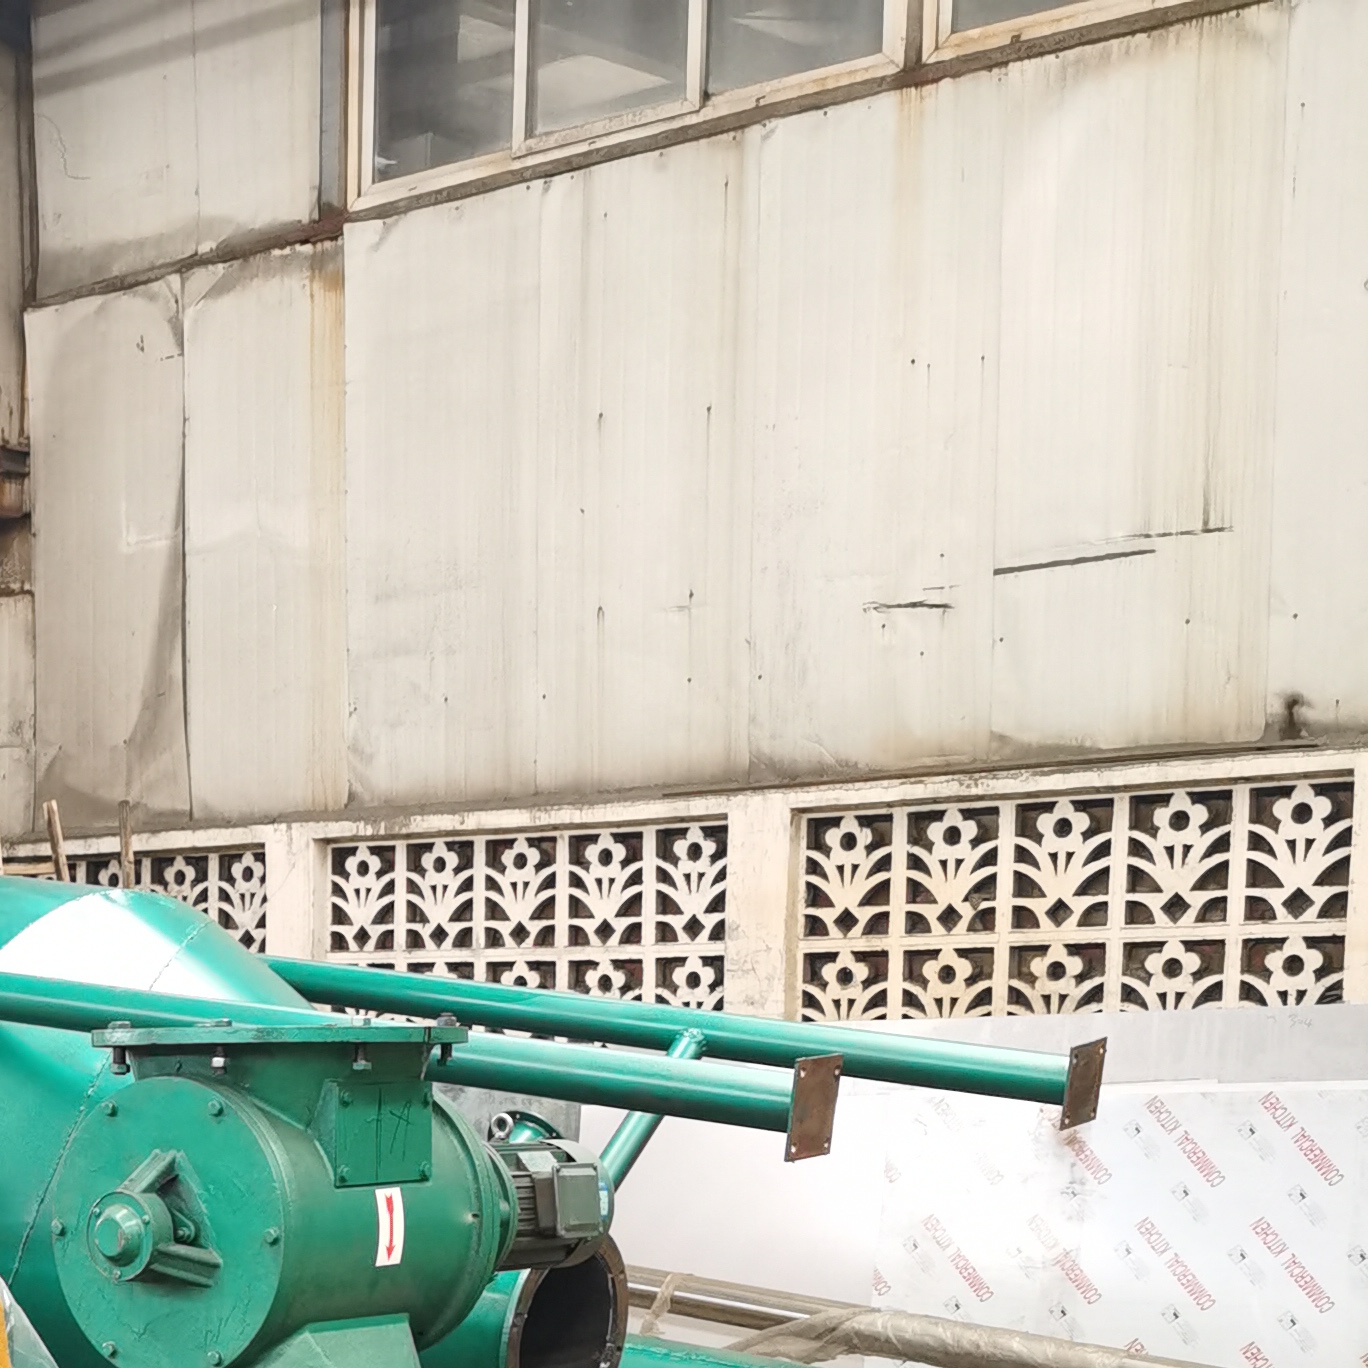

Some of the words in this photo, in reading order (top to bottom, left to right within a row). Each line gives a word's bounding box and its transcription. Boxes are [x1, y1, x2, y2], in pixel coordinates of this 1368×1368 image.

[1144, 1095, 1182, 1136] KITCHEN
[1258, 1090, 1298, 1132] KITCHEN
[1174, 1129, 1226, 1188] COMMERCIAL
[1291, 1126, 1345, 1187] COMMERCIAL
[921, 1213, 955, 1252] KITCHEN
[1134, 1216, 1173, 1258] KITCHEN
[1249, 1216, 1290, 1258] KITCHEN
[947, 1246, 995, 1303] COMMERCIAL
[1051, 1247, 1103, 1305] COMMERCIAL
[1164, 1252, 1217, 1311] COMMERCIAL
[1281, 1253, 1336, 1314] COMMERCIAL
